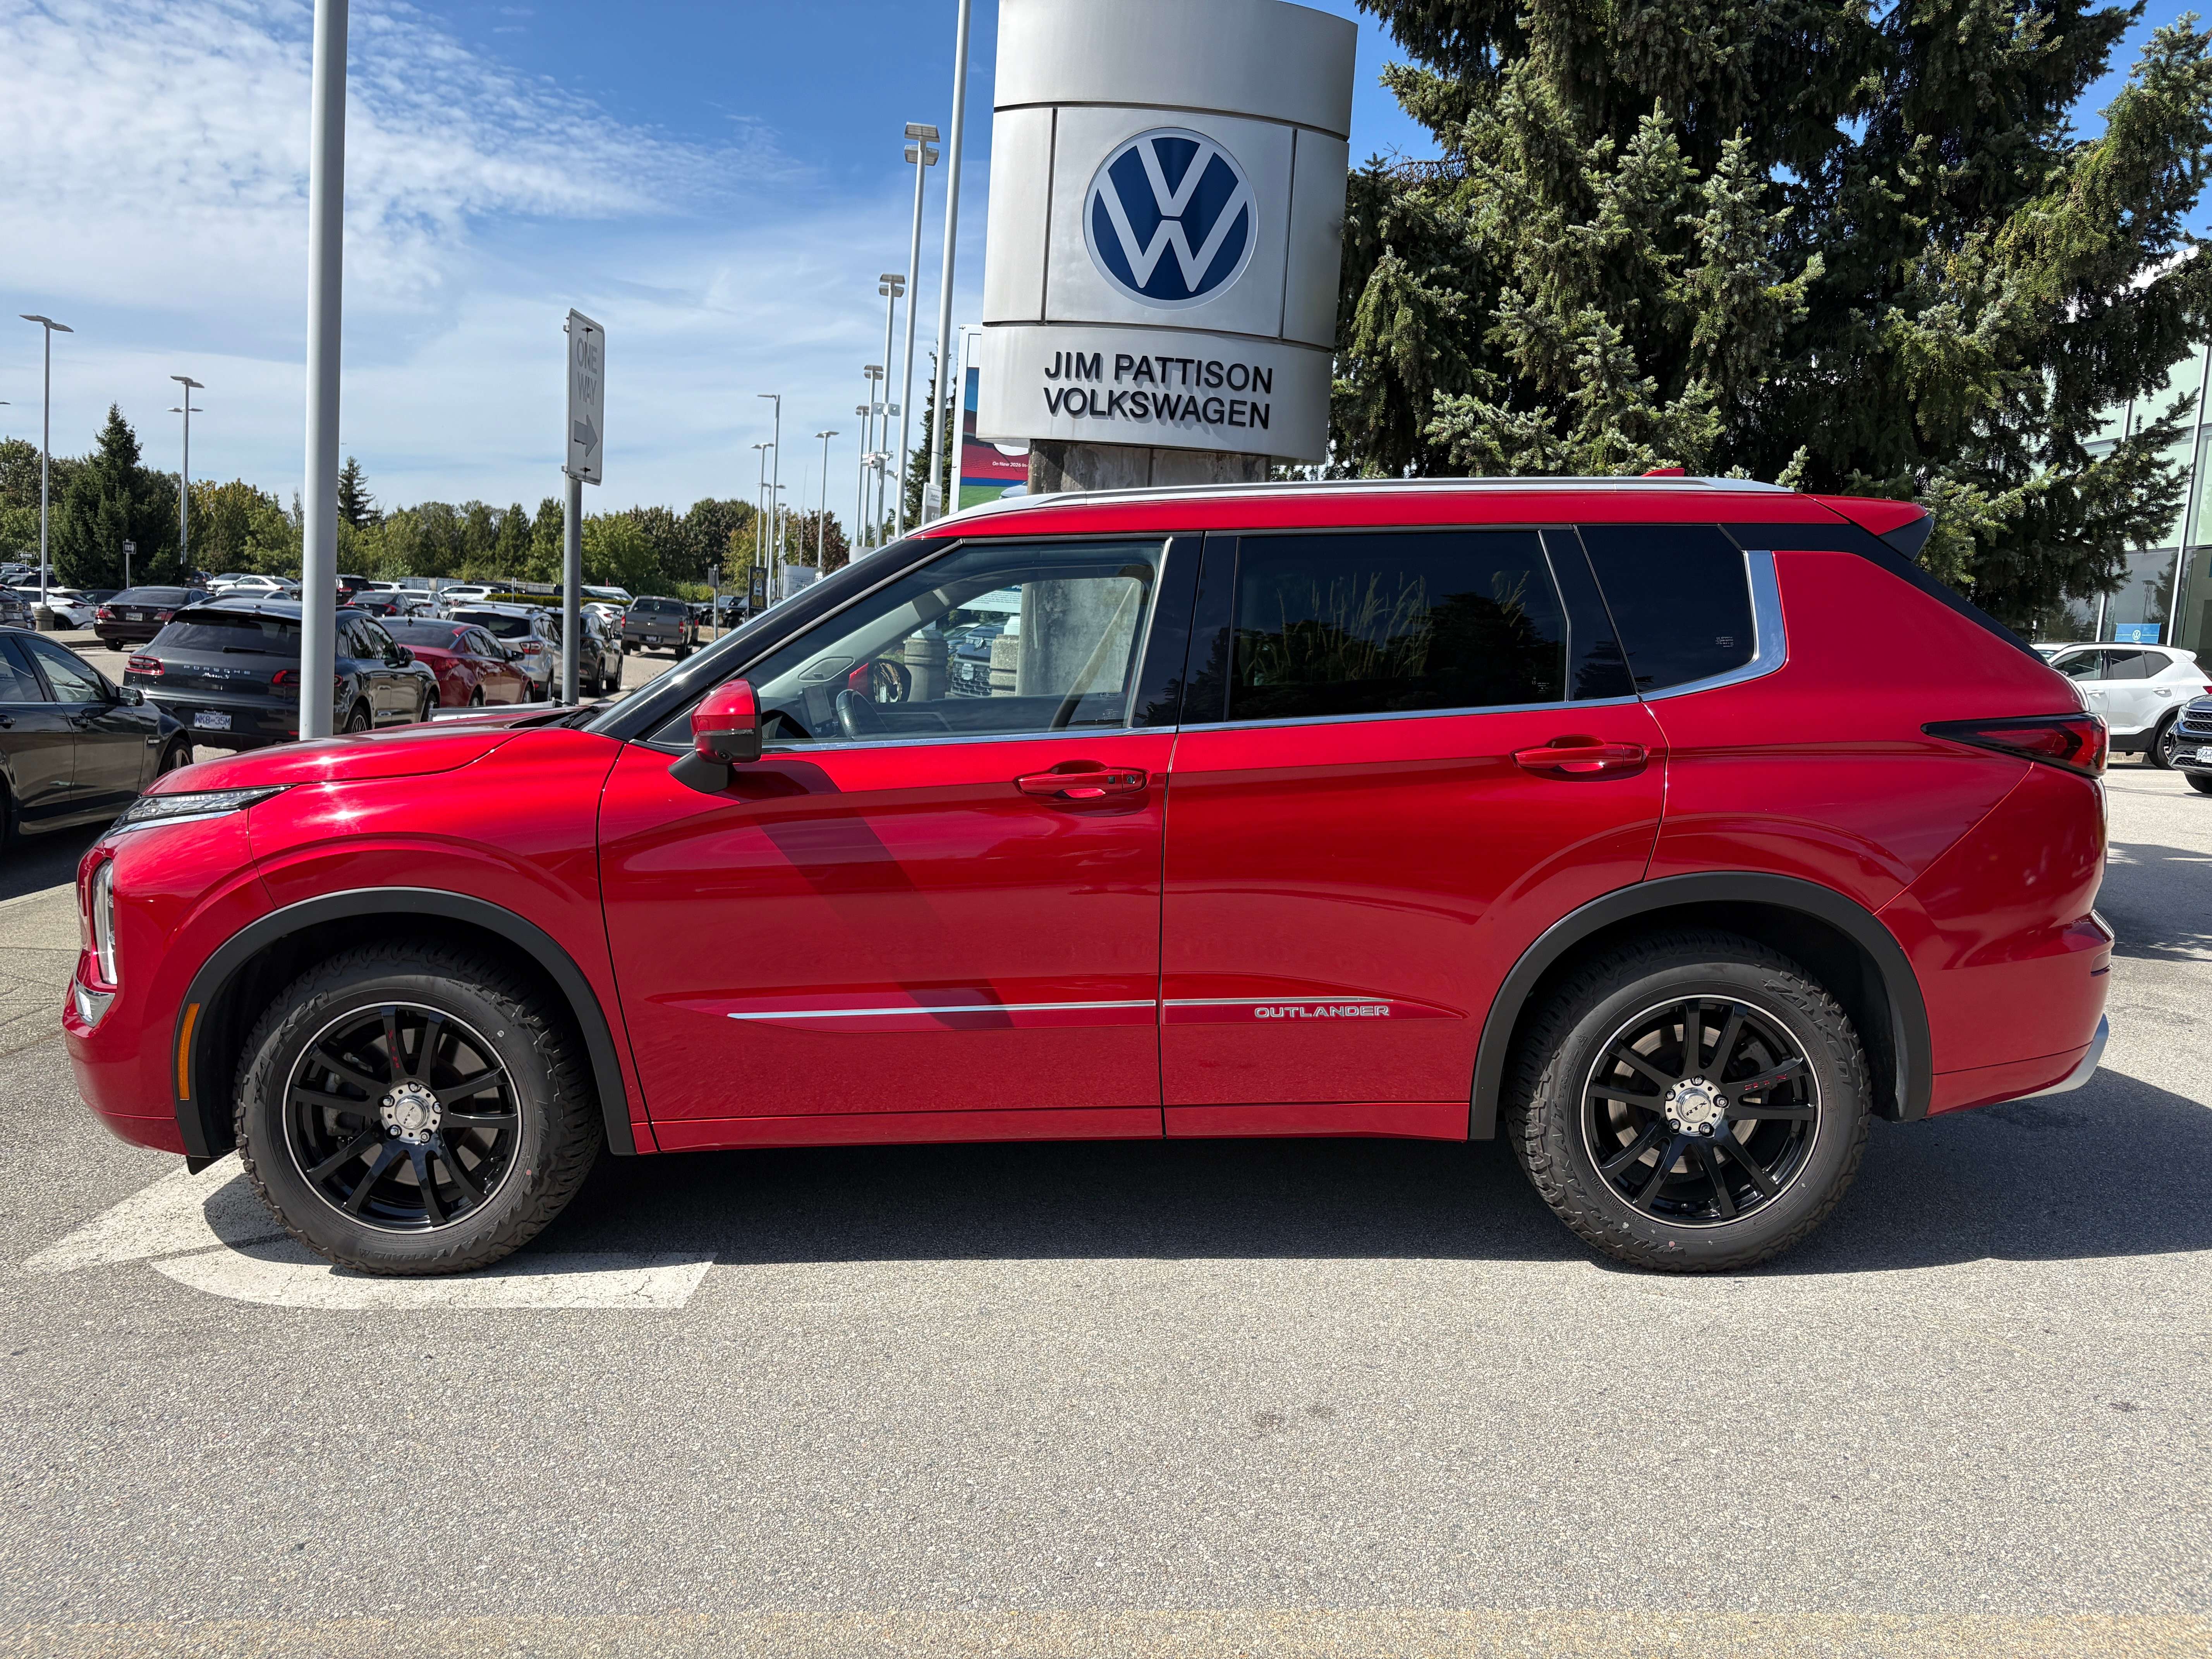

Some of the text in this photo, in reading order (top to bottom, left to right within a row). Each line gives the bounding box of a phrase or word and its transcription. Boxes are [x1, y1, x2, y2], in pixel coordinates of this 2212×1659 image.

[1091, 136, 1251, 301] VW
[577, 337, 598, 374] ONE
[1044, 351, 1273, 393] JIM PATTISON
[577, 372, 597, 406] WAY
[1043, 387, 1270, 430] VOLKSWAGEN
[1255, 1005, 1389, 1018] OUTLANDER
[1685, 1101, 1707, 1116] RTX
